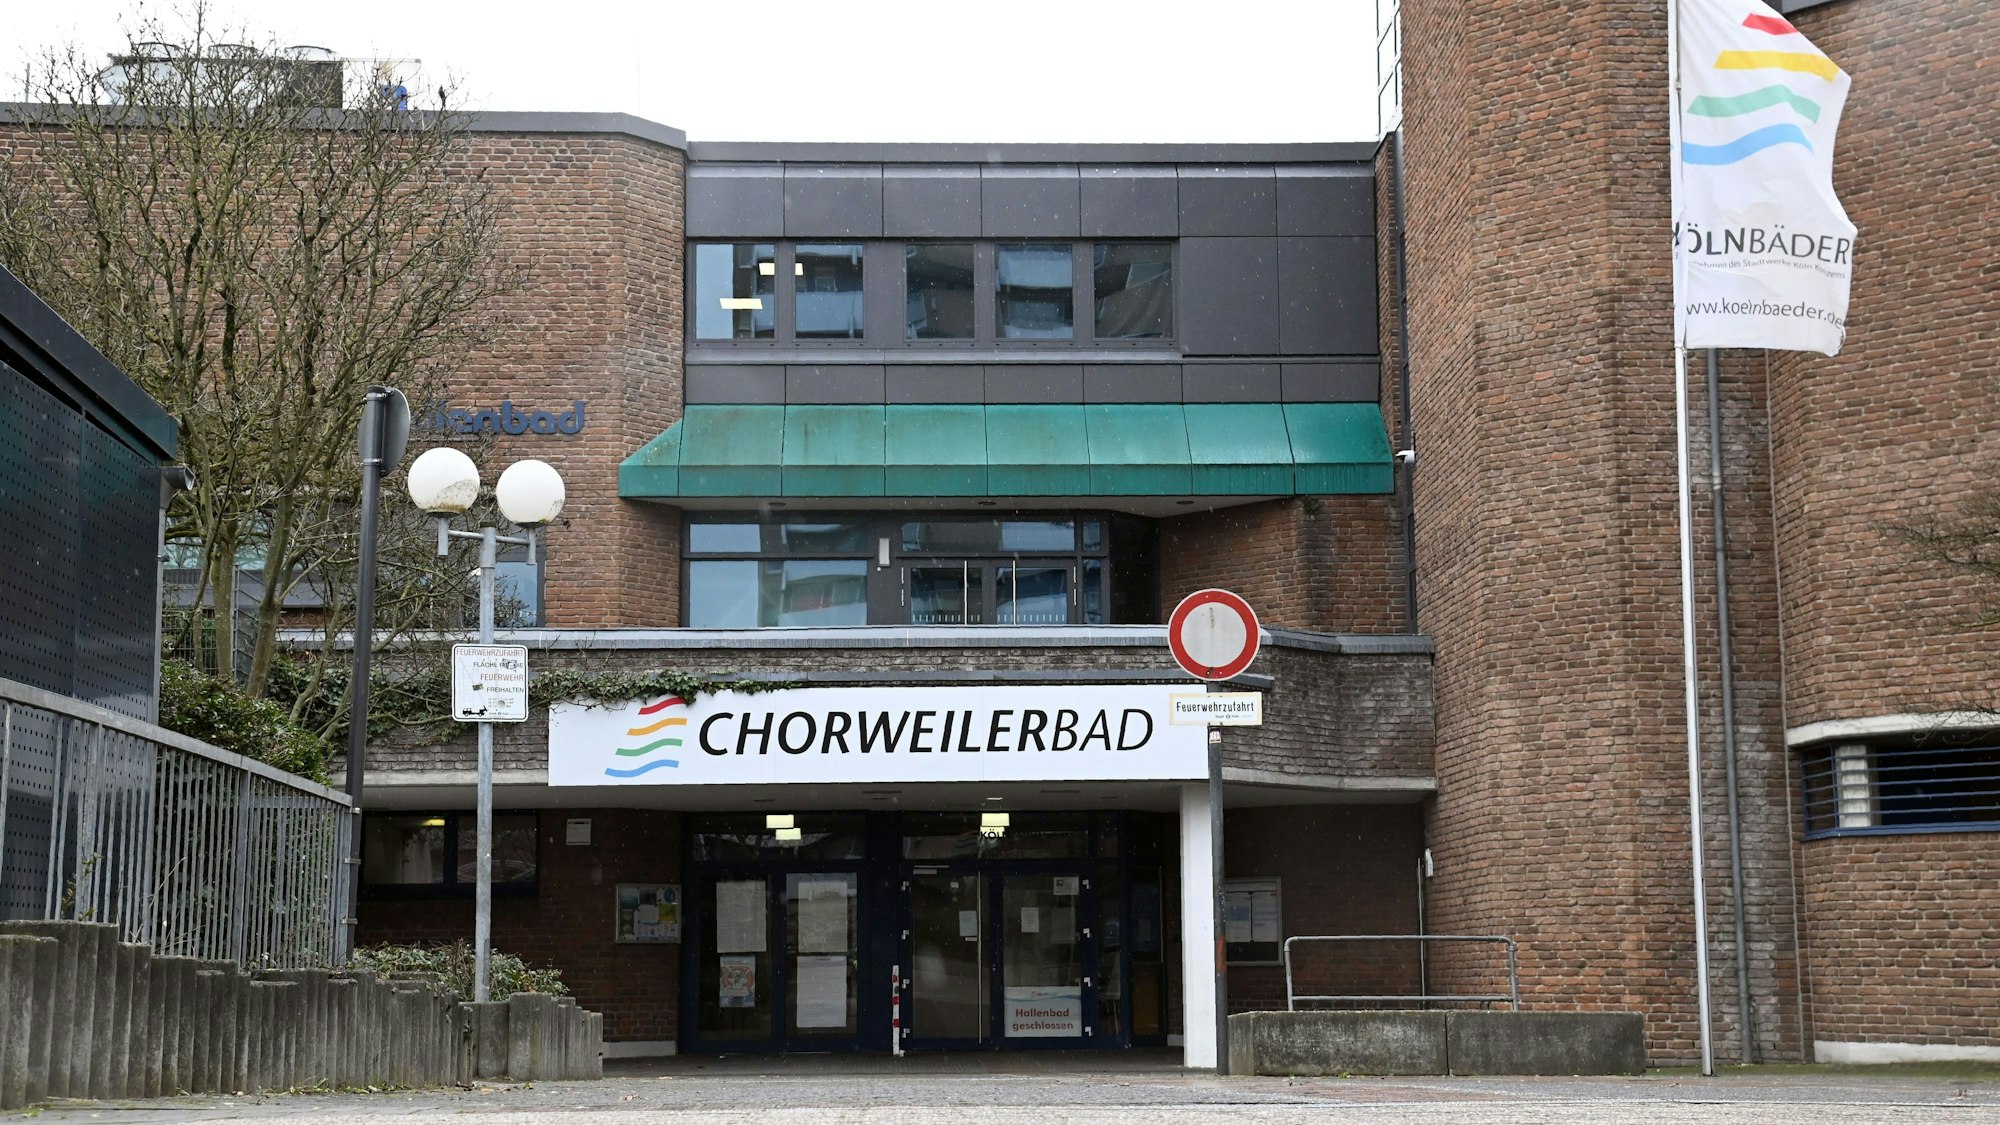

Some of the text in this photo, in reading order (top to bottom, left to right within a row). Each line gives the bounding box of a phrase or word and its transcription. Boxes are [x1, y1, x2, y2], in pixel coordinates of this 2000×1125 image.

[457, 649, 524, 657] FEUERWEHRZUFAHRT
[480, 673, 524, 682] FEUERWEHR
[1176, 701, 1254, 712] Feuerwehrzufahrt
[699, 708, 1153, 754] CHORWEILERBAD
[1015, 1008, 1070, 1018] Hallenbad
[1012, 1021, 1074, 1032] geschlossen
